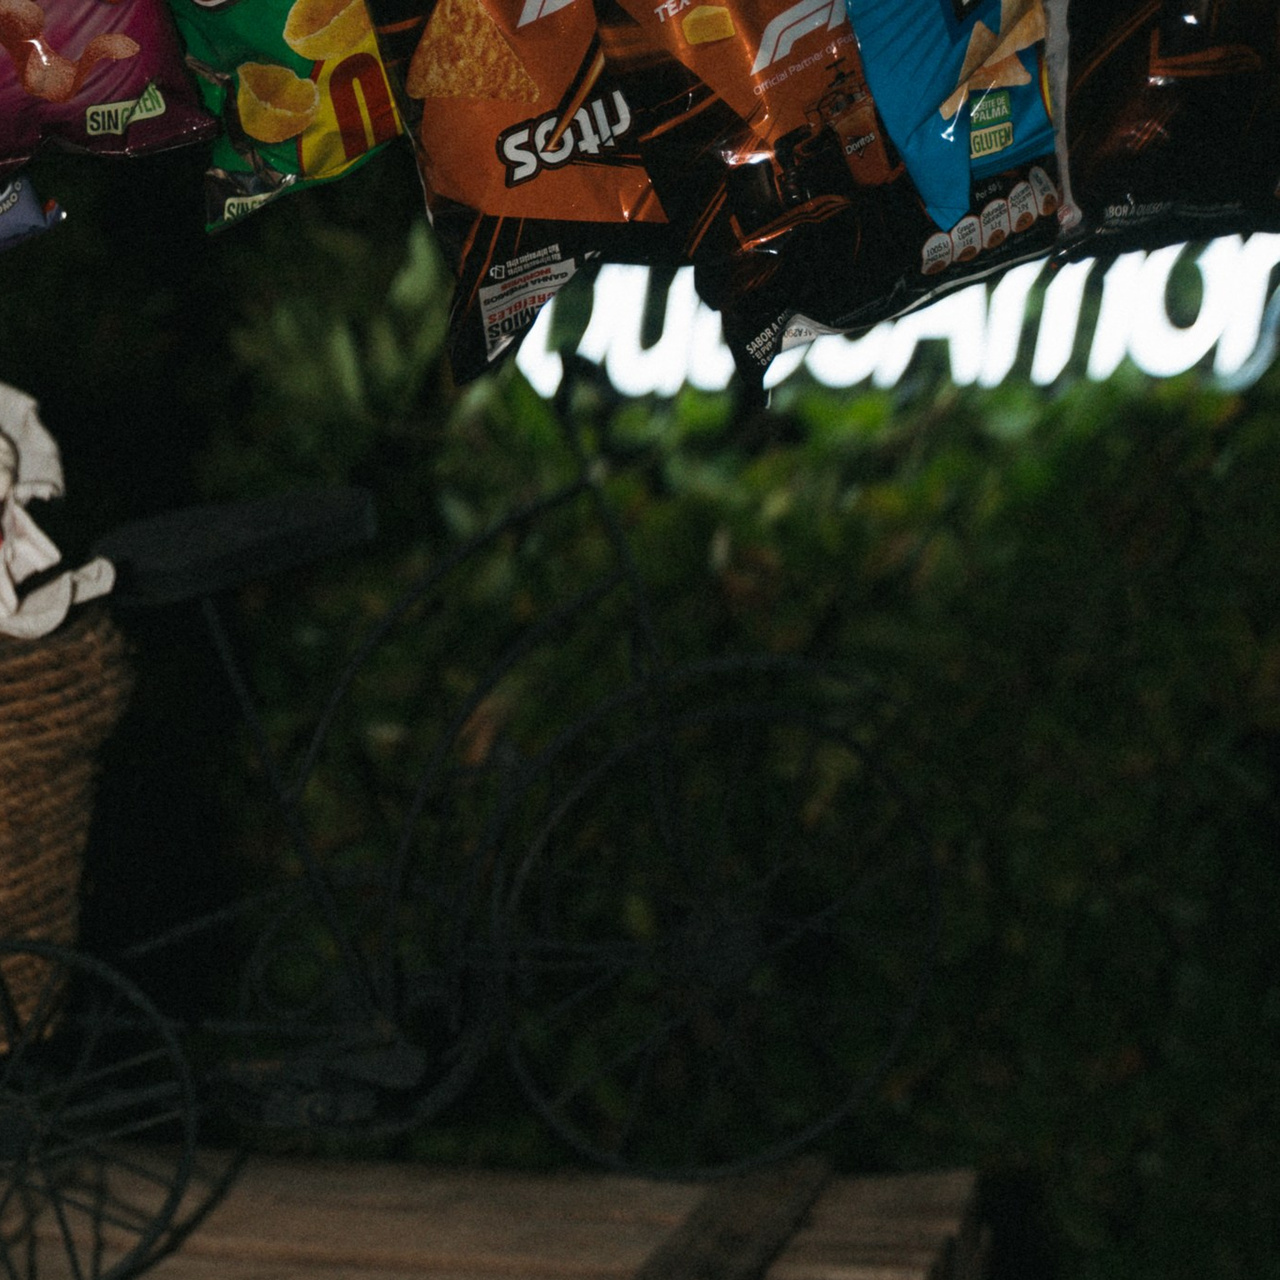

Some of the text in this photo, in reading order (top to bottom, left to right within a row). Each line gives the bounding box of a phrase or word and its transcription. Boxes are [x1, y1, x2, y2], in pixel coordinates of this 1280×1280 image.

[753, 70, 788, 96] Official
[788, 50, 824, 76] Partner
[89, 109, 119, 131] SIN
[972, 105, 1009, 123] PALMA
[503, 90, 631, 181] ritos
[972, 126, 1011, 154] GLUTEN
[745, 328, 774, 355] SABOR
